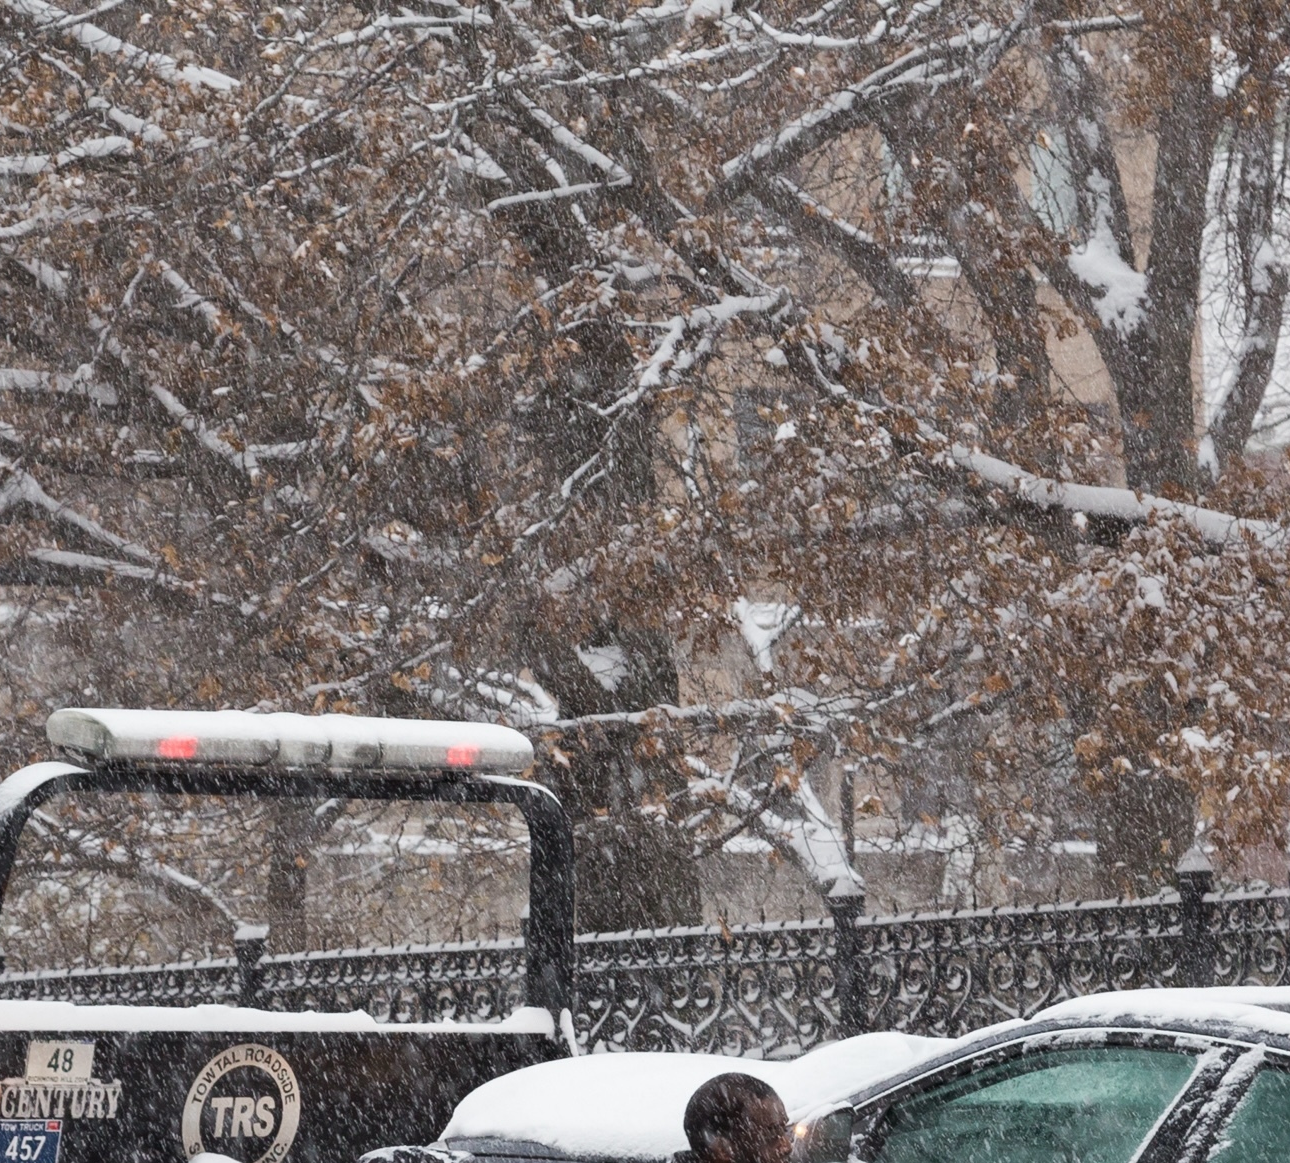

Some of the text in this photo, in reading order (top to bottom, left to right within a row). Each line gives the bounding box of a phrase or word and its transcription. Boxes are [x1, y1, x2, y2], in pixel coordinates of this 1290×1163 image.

[47, 1048, 74, 1073] 48
[0, 1085, 123, 1119] CENTURY
[0, 1123, 17, 1131] TOW
[19, 1123, 44, 1131] TRUCK
[210, 1096, 274, 1138] TRS
[5, 1136, 46, 1161] 457
